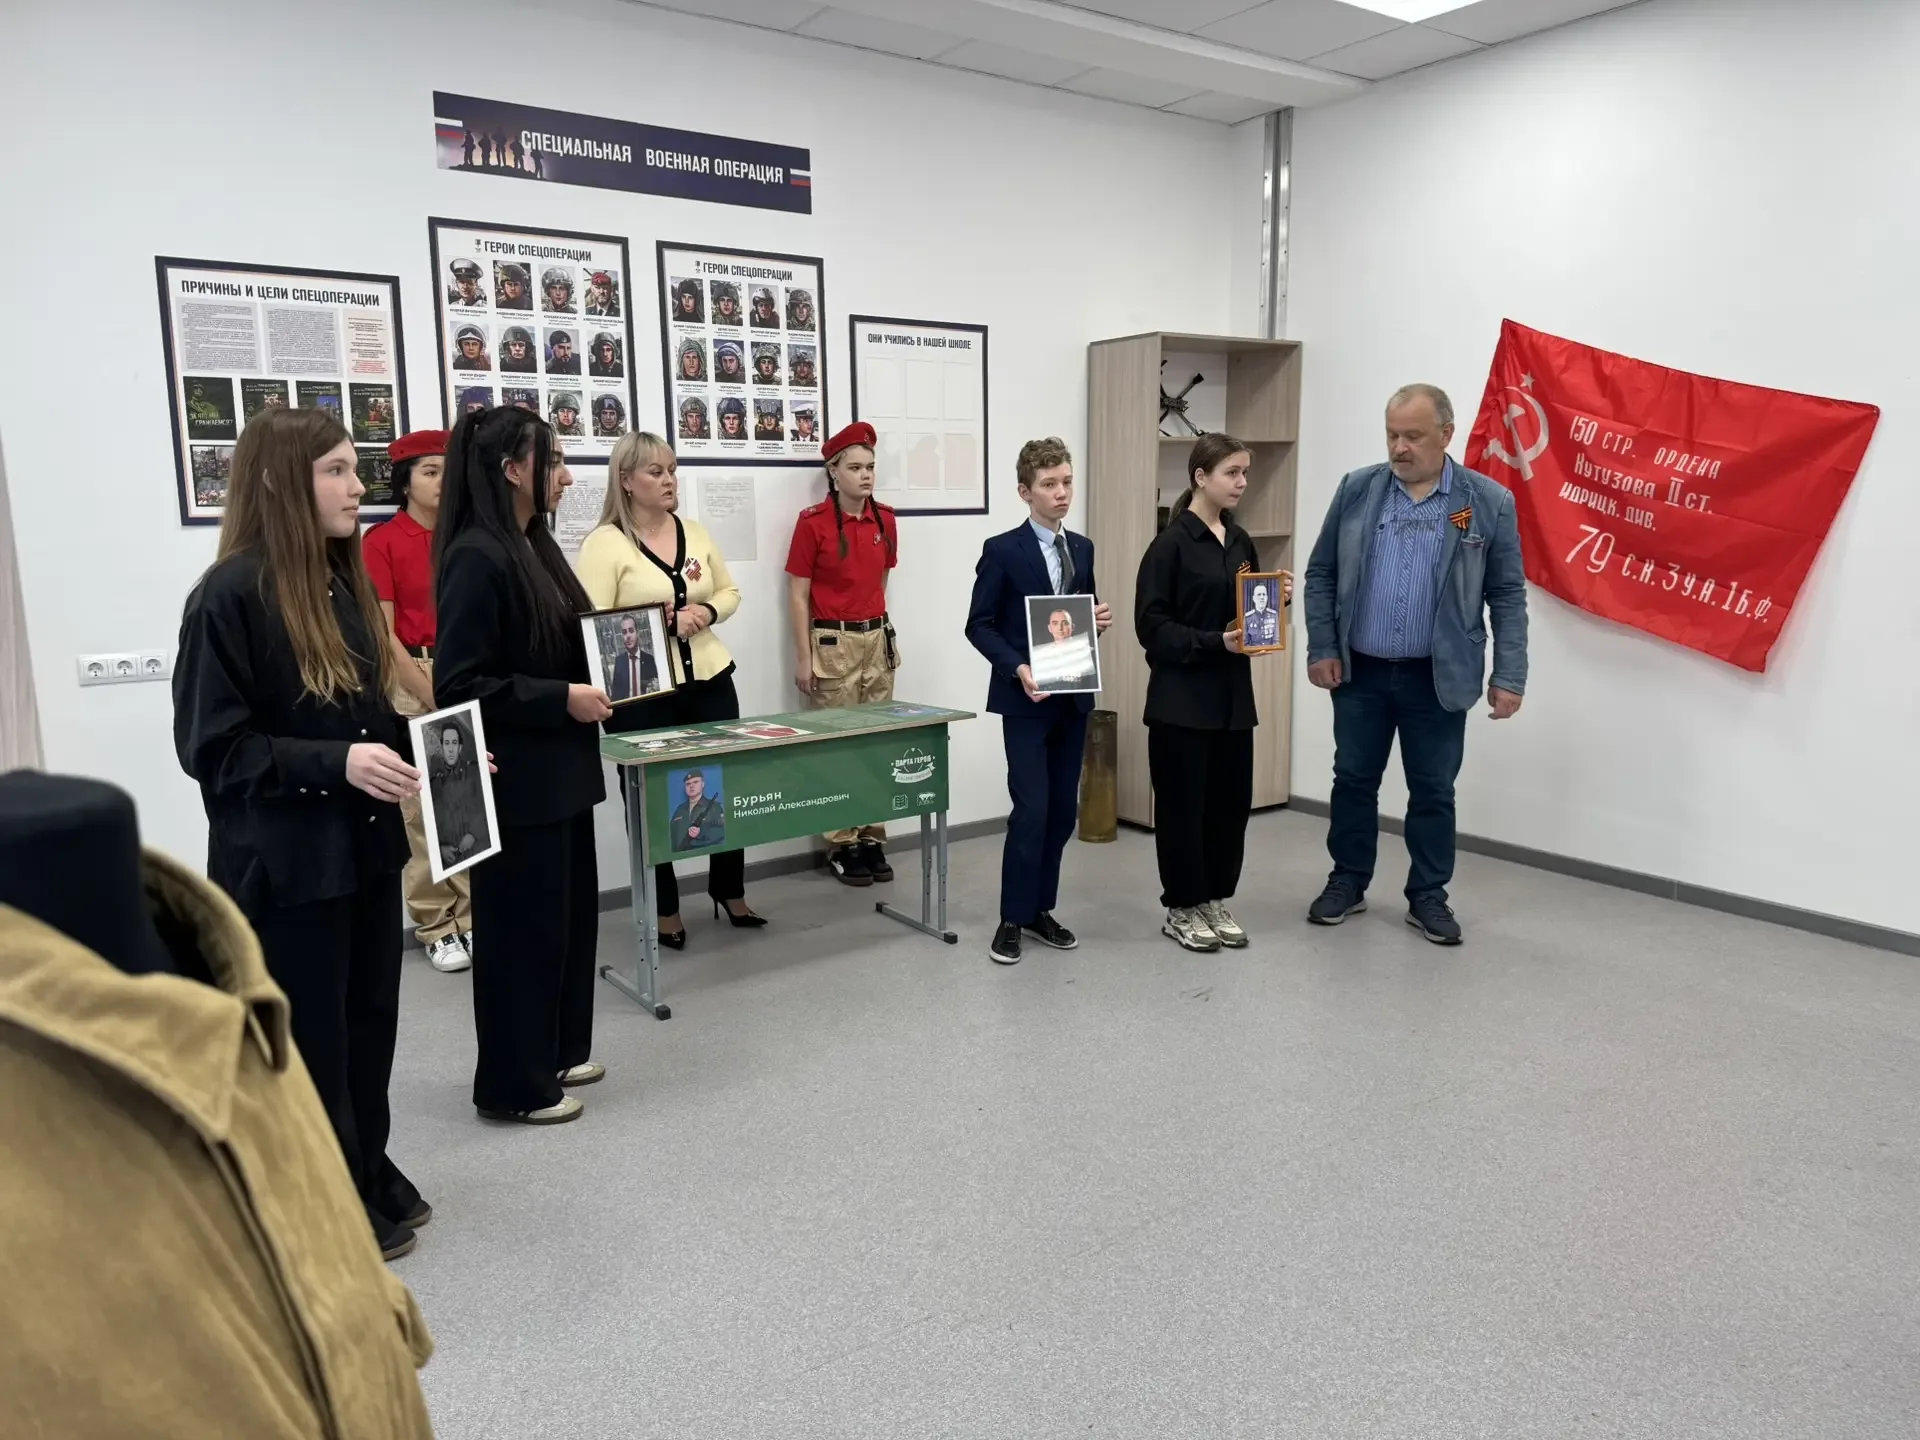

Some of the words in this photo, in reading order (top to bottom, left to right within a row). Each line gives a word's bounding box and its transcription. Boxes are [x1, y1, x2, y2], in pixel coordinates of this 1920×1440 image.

[521, 130, 632, 163] СПЕЦИАЛЬНАЯ
[646, 148, 710, 174] ВОЕННАЯ
[714, 158, 784, 184] ОПЕРАЦИЯ
[484, 240, 515, 256] ГЕРОИ
[518, 243, 592, 262] СПЕЦОПЕРАЦИИ
[703, 261, 730, 276] ГЕРОИ
[731, 263, 793, 281] СПЕЦОПЕРАЦИИ
[181, 280, 242, 297] ПРИЧИНЫ
[245, 285, 254, 297] И
[257, 286, 289, 300] ЦЕЛИ
[292, 288, 380, 307] СПЕЦОПЕРАЦИИ
[867, 333, 883, 344] ОНИ
[884, 334, 915, 346] УЧИЛИСЬ
[916, 337, 921, 346] В
[923, 336, 947, 348] НАШЕЙ
[948, 339, 972, 350] ШКОЛЕ
[1569, 415, 1598, 445] 150
[1653, 447, 1721, 480] ОРДЕНА
[1564, 524, 1616, 574] 79
[733, 789, 782, 808] Бурьян
[733, 804, 776, 819] Николай
[778, 791, 850, 813] Александрович
